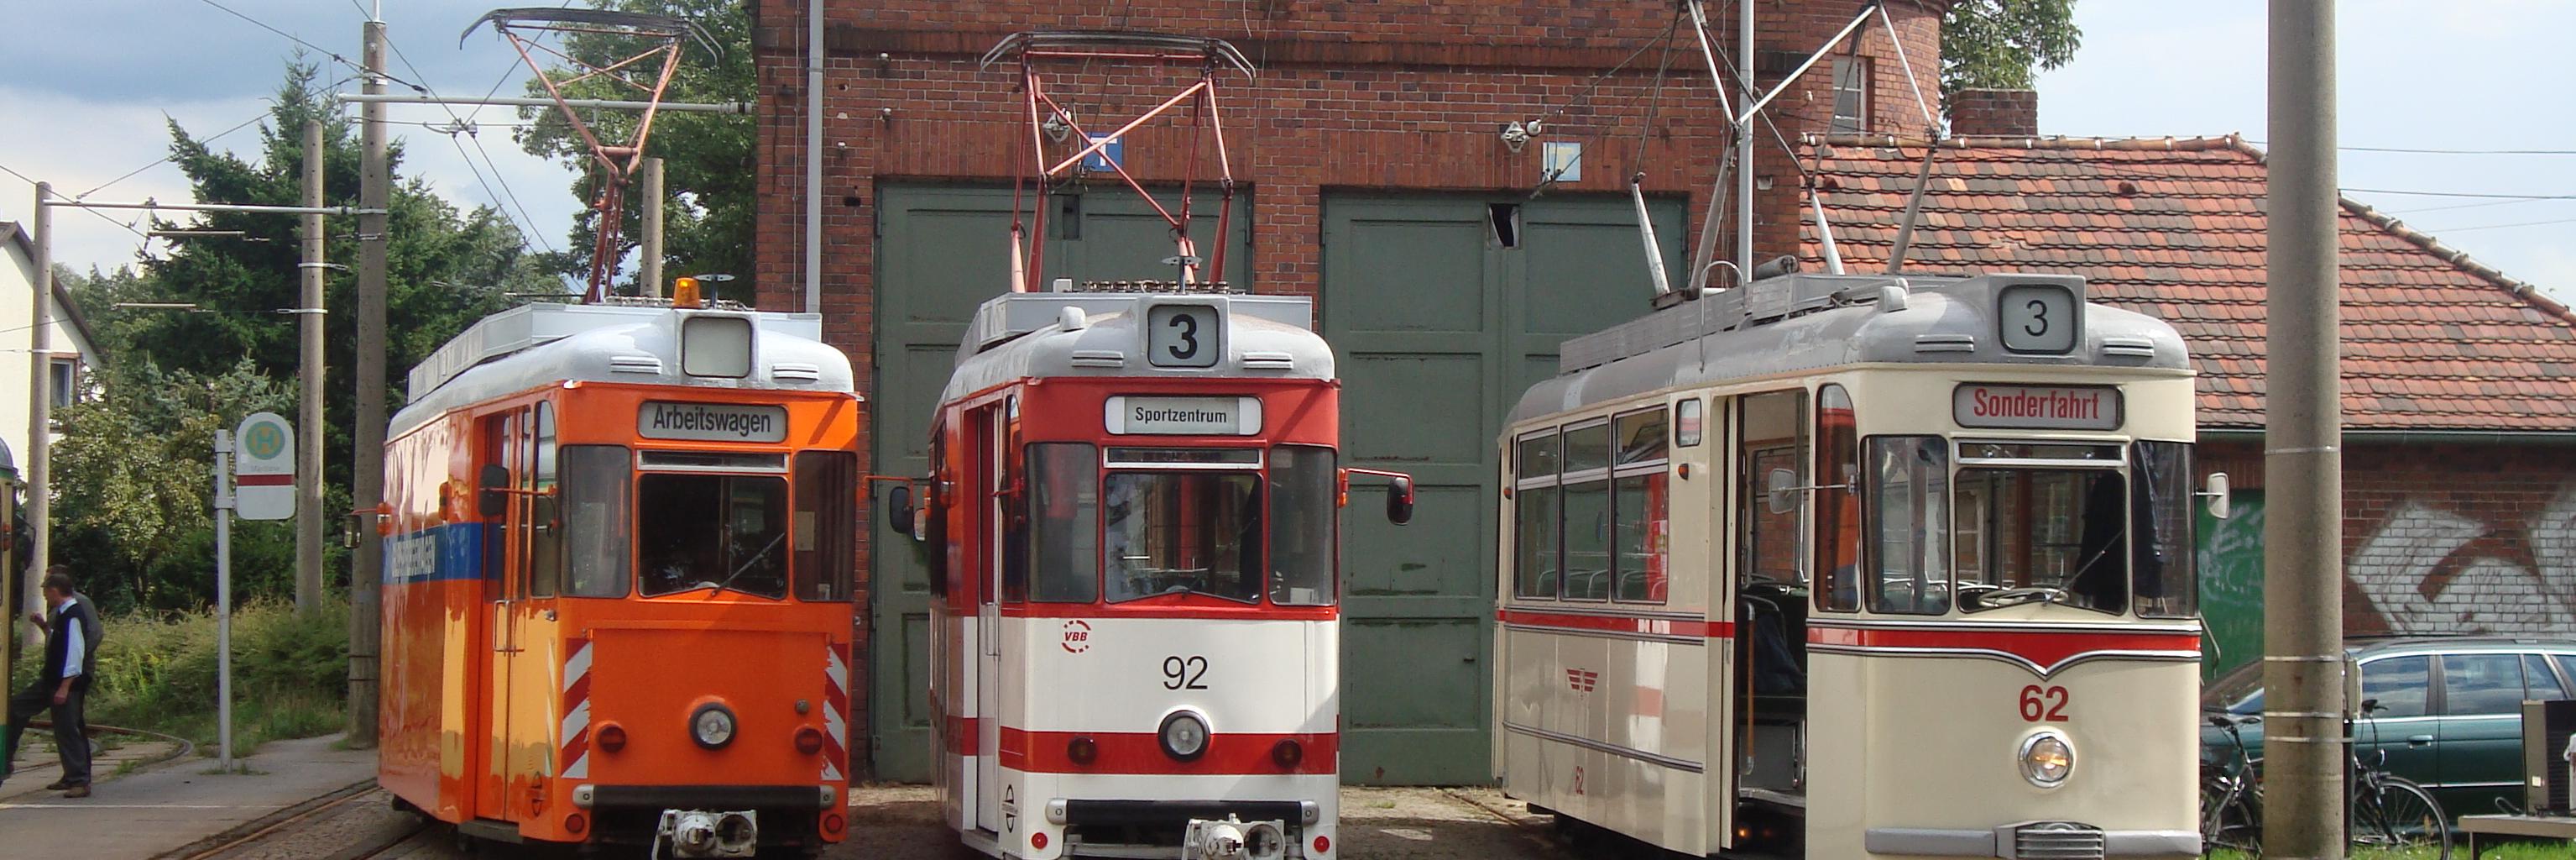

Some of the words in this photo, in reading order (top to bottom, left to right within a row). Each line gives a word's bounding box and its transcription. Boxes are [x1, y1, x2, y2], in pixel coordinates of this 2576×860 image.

[2025, 300, 2048, 337] 3
[1169, 314, 1197, 359] 3
[1135, 406, 1227, 424] Sportzentrum
[1973, 388, 2099, 419] Sonderfahrt
[652, 404, 771, 438] Arbeitswagen
[1064, 632, 1088, 642] VBB
[1163, 655, 1208, 690] 92
[2020, 684, 2069, 722] 62
[1575, 765, 1584, 795] 62
